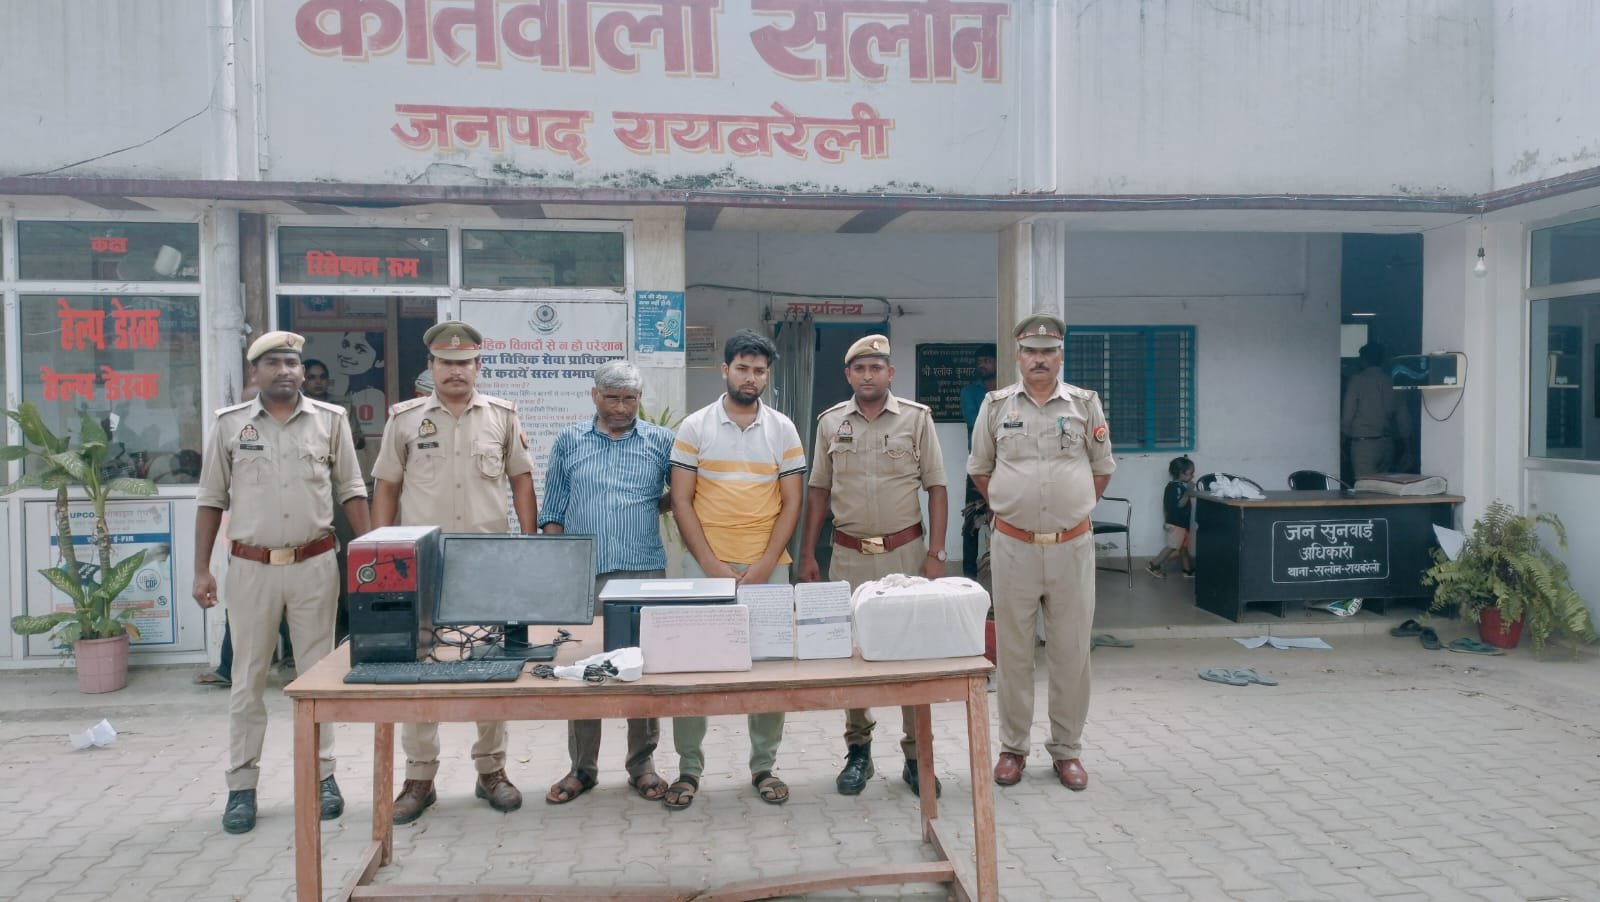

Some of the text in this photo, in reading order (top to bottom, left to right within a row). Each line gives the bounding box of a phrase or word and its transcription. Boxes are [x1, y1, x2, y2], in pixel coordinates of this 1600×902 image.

[390, 101, 895, 166] जनपद रायबरेली
[787, 301, 863, 315] कार्यालय
[57, 297, 161, 351] हेल्प डेस्क
[546, 340, 556, 351] से
[559, 341, 569, 351] न
[586, 339, 624, 351] परेशान
[500, 353, 539, 364] विधिक
[542, 353, 566, 364] सेवा
[481, 367, 493, 379] से
[531, 369, 559, 379] सरल
[70, 511, 96, 519] UPCO
[1284, 520, 1374, 544] जन सुनवाई
[1299, 542, 1355, 560] अधिकारी
